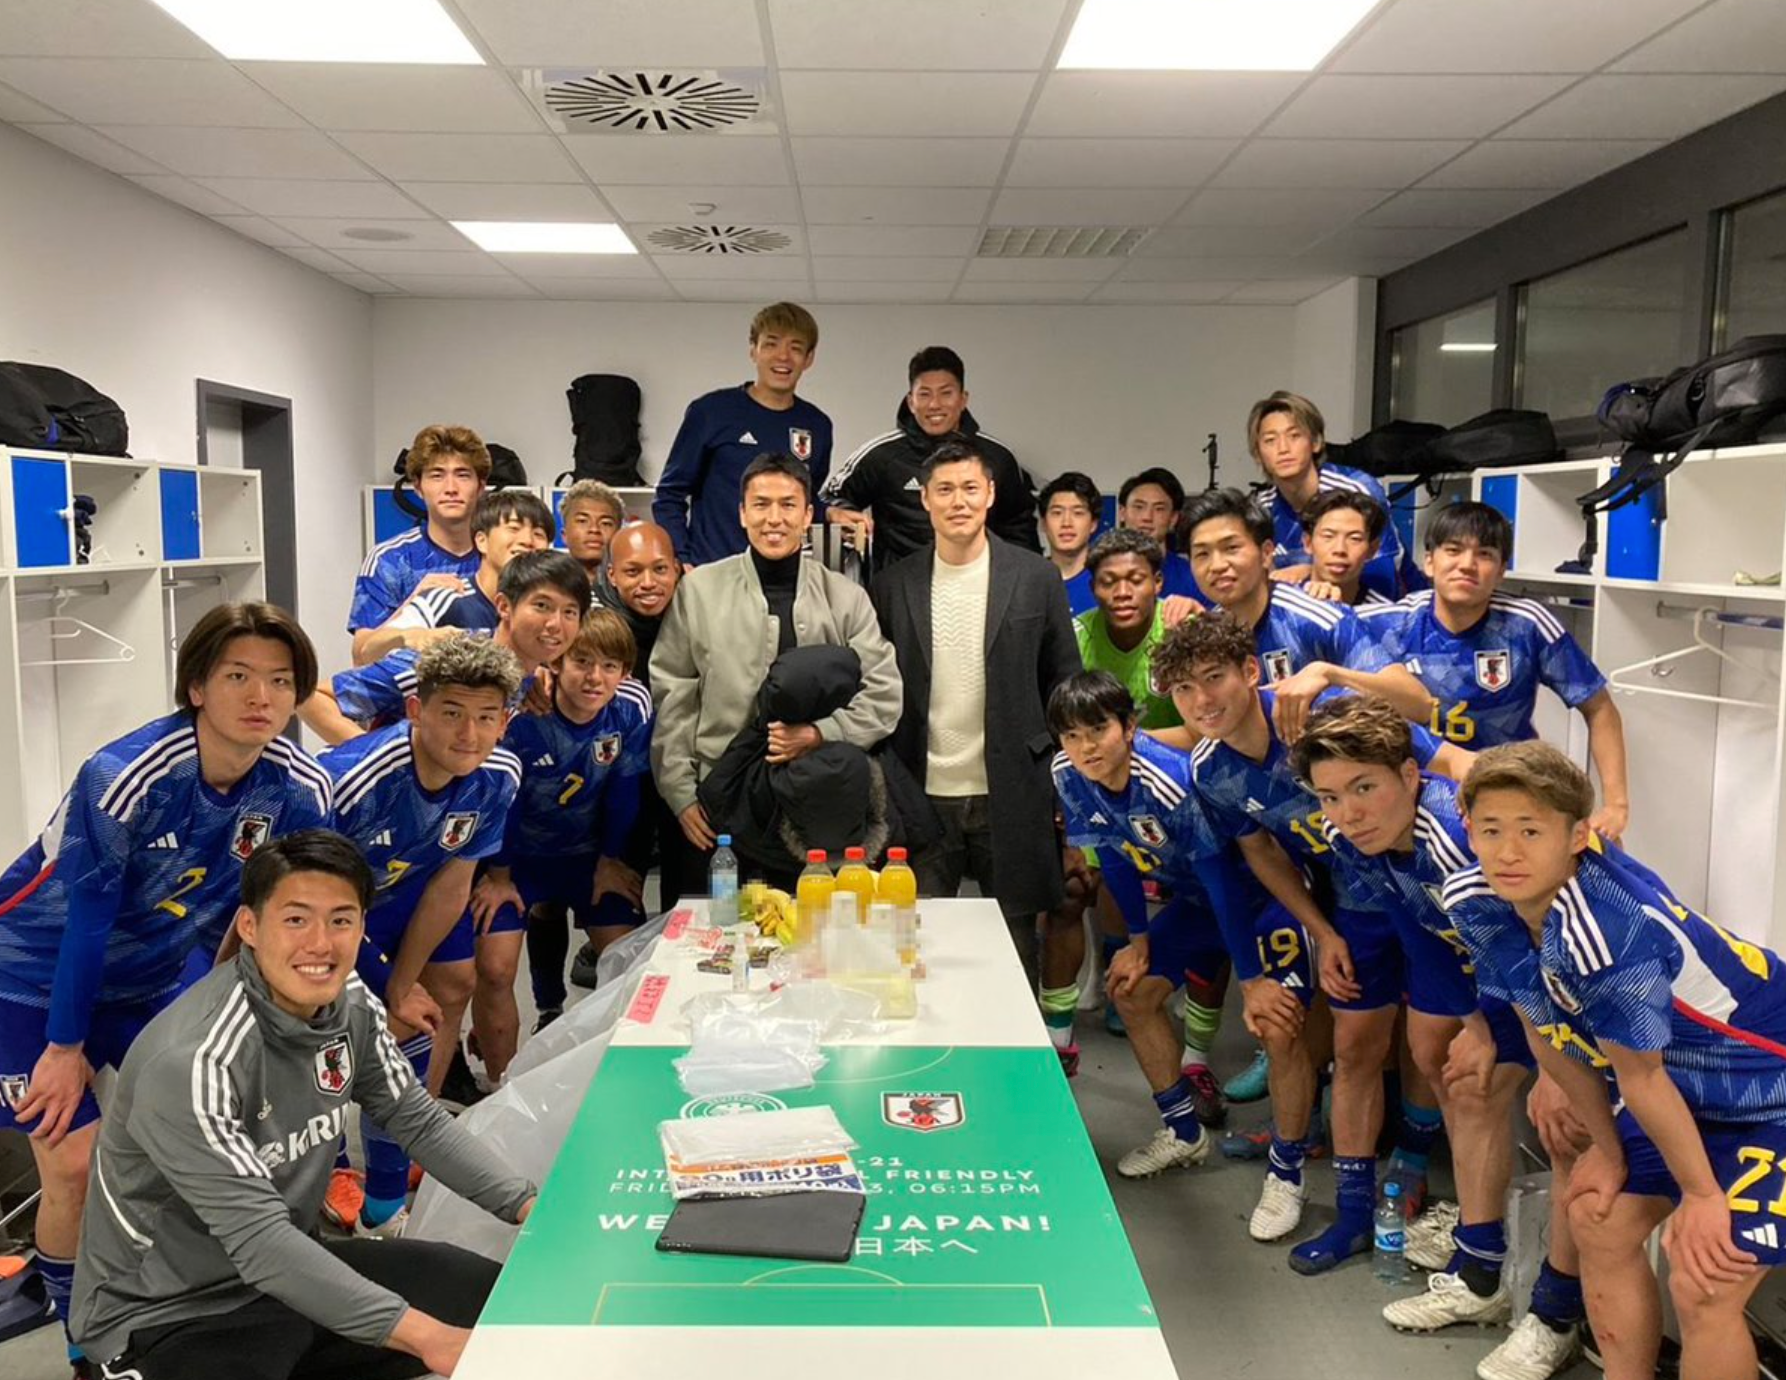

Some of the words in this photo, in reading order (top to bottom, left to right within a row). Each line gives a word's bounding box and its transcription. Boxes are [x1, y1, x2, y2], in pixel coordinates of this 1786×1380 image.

[1429, 696, 1475, 742] 16
[558, 773, 584, 805] 7
[153, 867, 207, 919] 2
[1256, 927, 1300, 972] 19
[886, 1169, 1034, 1180] FRIENDLY
[909, 1183, 1041, 1194] 06:15PM
[872, 1214, 1051, 1231] JAPAN!
[855, 1235, 979, 1257] 日本へ
